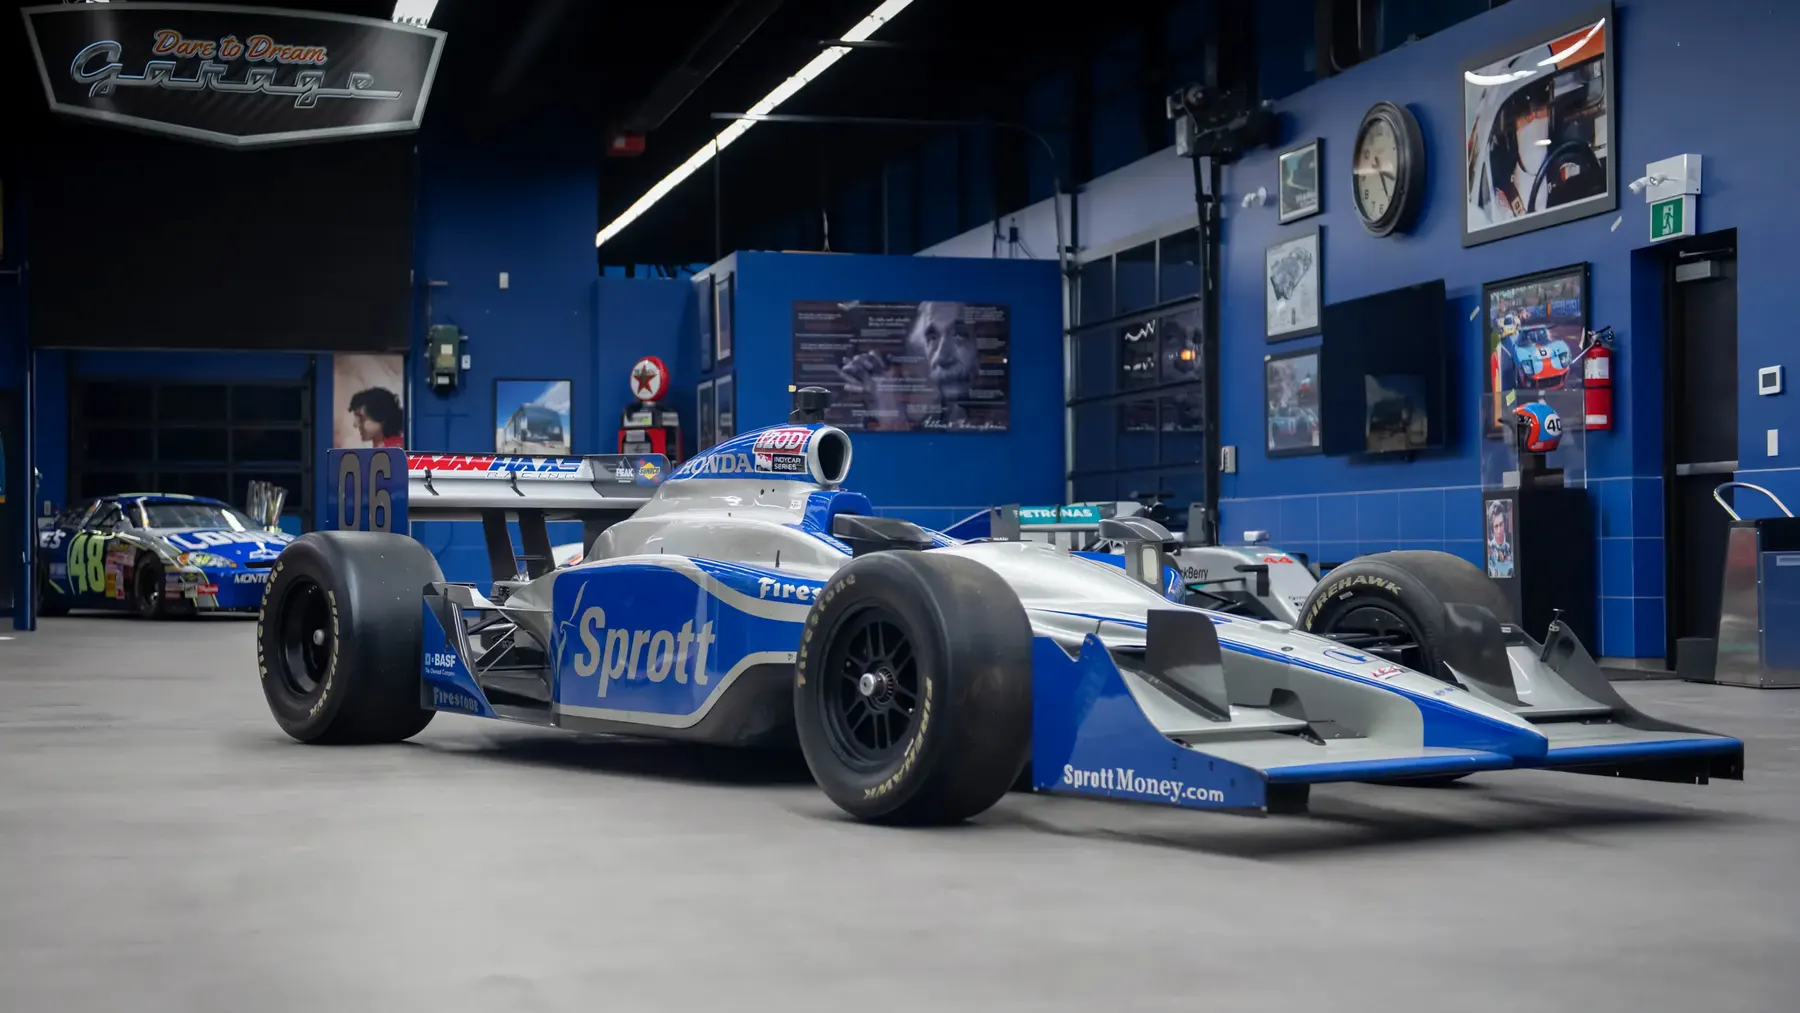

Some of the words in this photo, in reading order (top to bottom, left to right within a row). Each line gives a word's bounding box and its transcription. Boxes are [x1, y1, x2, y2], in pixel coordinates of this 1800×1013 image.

[154, 30, 214, 59] Dare
[219, 34, 242, 60] to
[247, 35, 328, 65] Dream
[70, 40, 402, 109] Garage
[756, 431, 803, 449] IZOD
[616, 467, 634, 477] PEAK
[675, 453, 753, 475] HONDA
[337, 452, 391, 531] 06
[69, 533, 105, 594] 48
[758, 577, 824, 601] Fires
[1305, 575, 1402, 631] FIREHAWK
[434, 653, 456, 667] BASF
[574, 606, 716, 698] Sprott
[433, 686, 479, 712] Firestone
[864, 677, 932, 799] FIREHAWK
